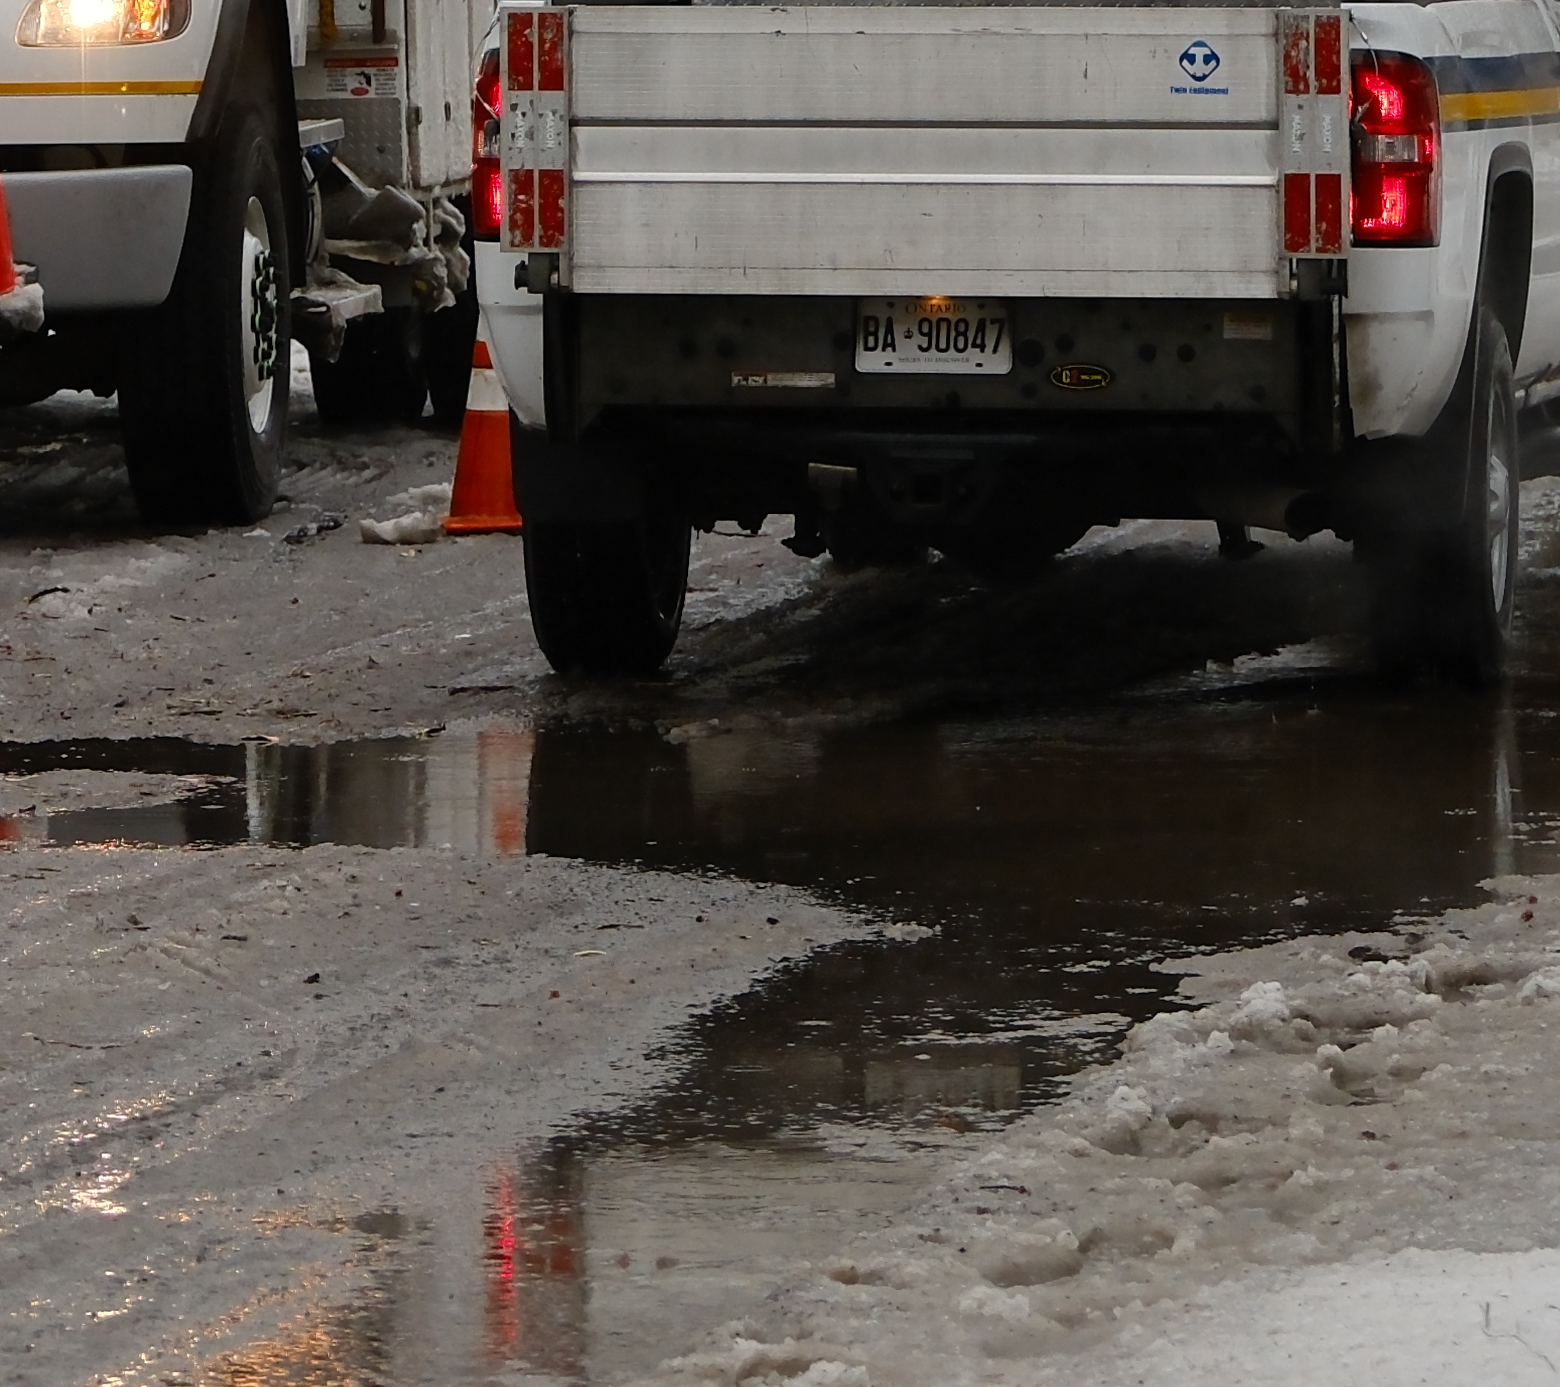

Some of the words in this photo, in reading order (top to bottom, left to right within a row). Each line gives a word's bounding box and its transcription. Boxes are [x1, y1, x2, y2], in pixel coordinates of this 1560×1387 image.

[905, 302, 967, 315] ONTARIO
[863, 315, 897, 353] BA
[917, 317, 1005, 355] 90847
